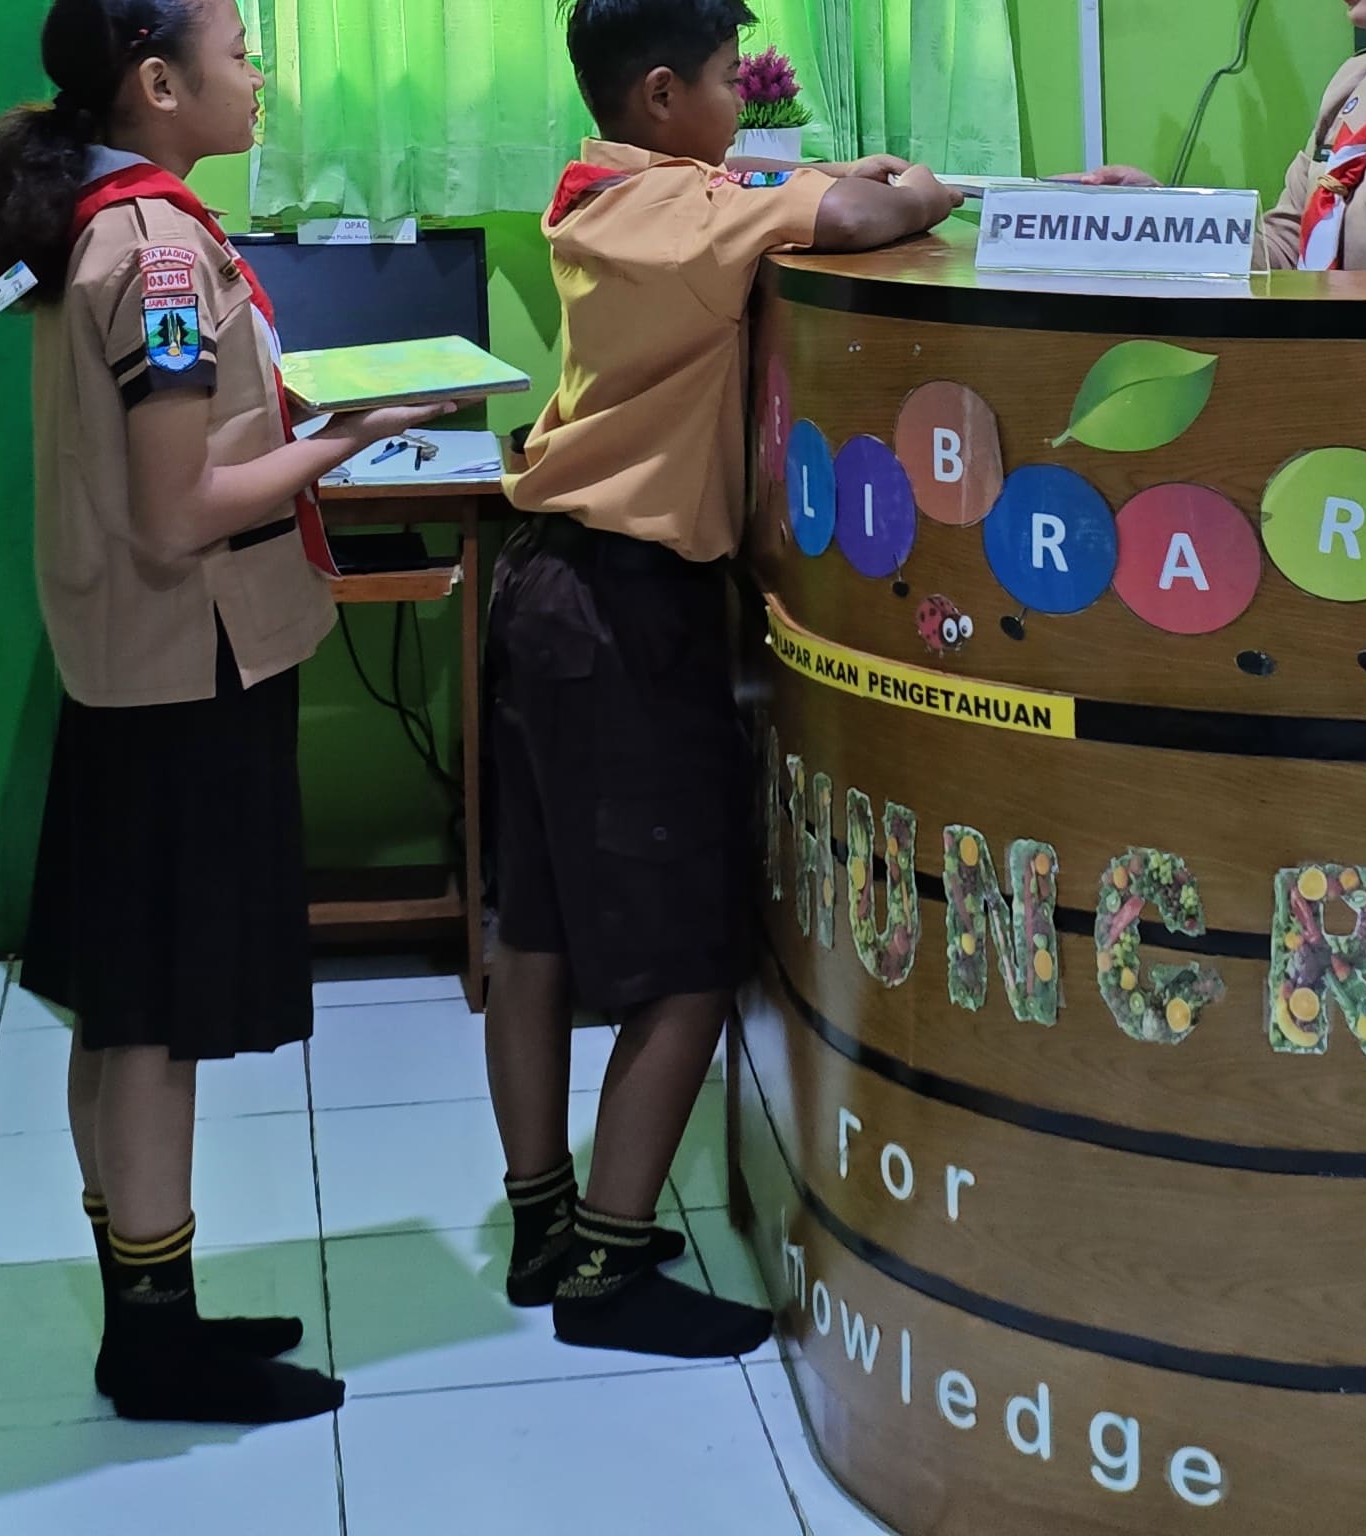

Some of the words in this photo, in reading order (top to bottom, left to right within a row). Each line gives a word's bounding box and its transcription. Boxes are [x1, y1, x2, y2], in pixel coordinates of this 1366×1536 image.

[344, 221, 367, 229] OPAC
[990, 213, 1253, 246] PEMINJAMAN
[159, 249, 194, 262] MADIUN
[149, 273, 187, 287] 03.016
[815, 652, 860, 688] AKAN
[867, 671, 1053, 731] PENGETAHUAN
